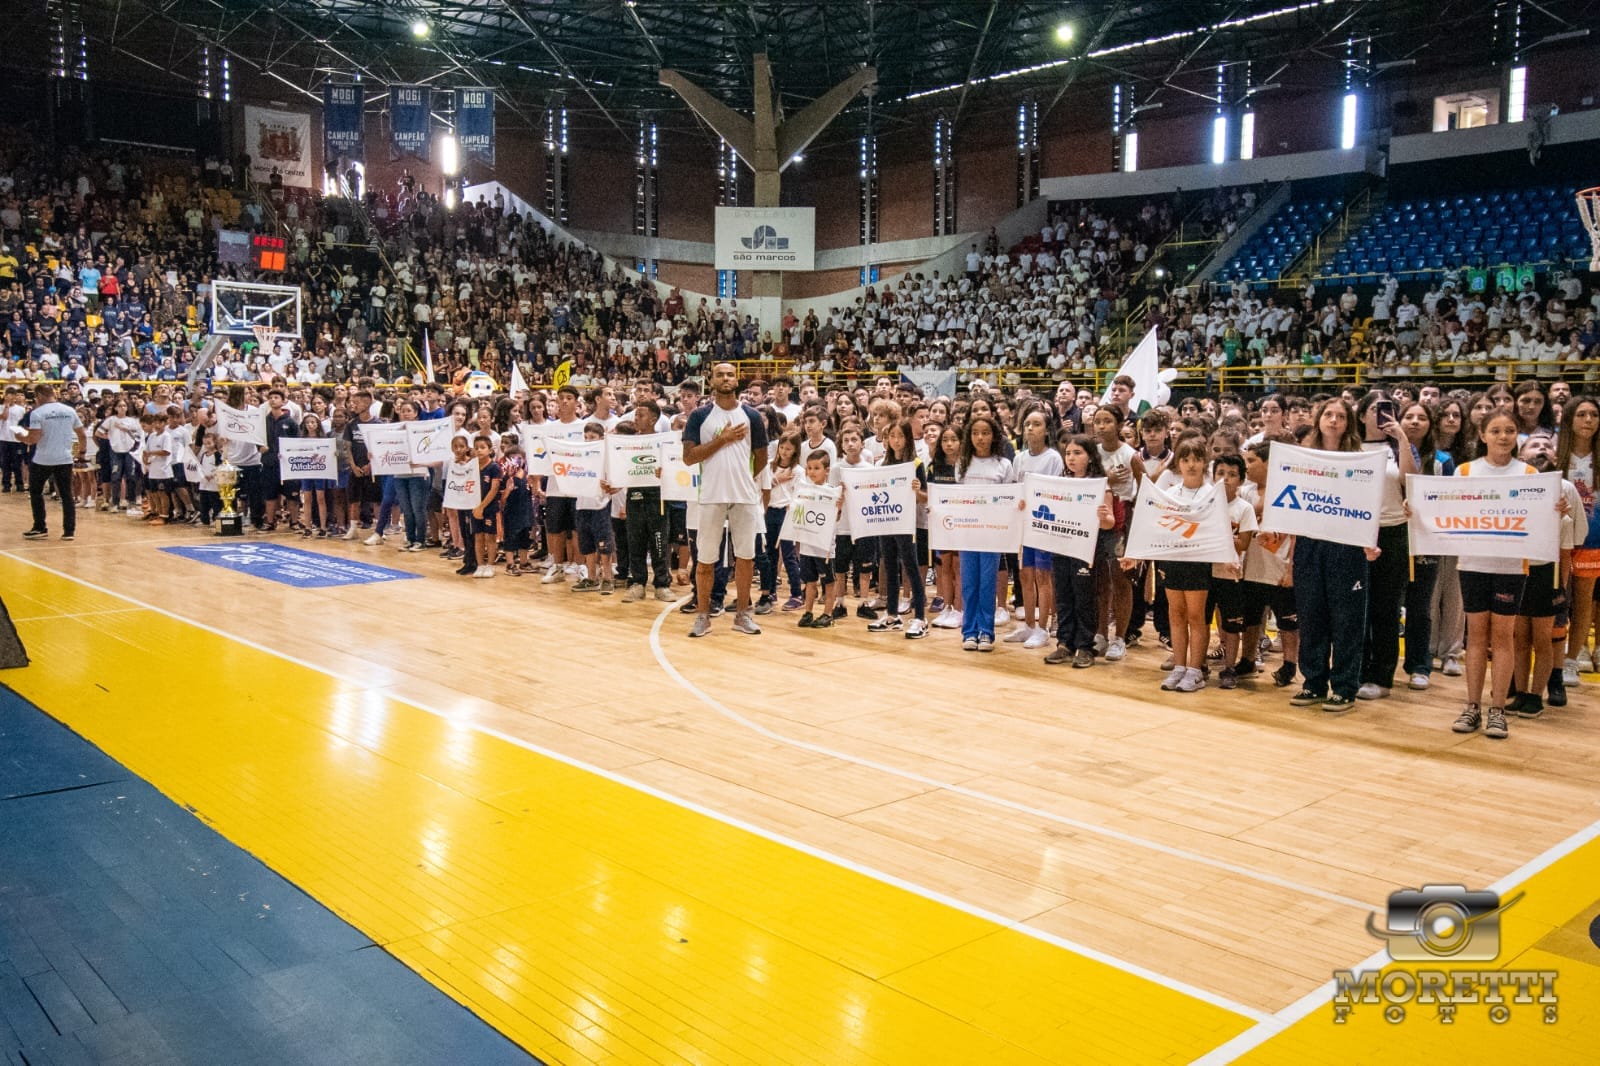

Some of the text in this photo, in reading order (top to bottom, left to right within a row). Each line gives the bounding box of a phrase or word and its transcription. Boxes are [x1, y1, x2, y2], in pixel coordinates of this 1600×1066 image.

[332, 88, 355, 100] MOGI
[398, 90, 421, 101] MOGI
[463, 92, 485, 104] MOGI
[327, 130, 359, 140] CAMPEÃO
[394, 131, 425, 141] CAMPEÃO
[460, 135, 489, 144] CAMPEÃO
[291, 463, 326, 471] Alfabeto
[1301, 492, 1341, 505] TOMÁS
[861, 504, 903, 516] OBJETIVO
[1306, 504, 1372, 520] AGOSTINHO
[1480, 507, 1528, 515] COLÉGIO
[1435, 516, 1527, 530] UNISUZ
[1032, 521, 1049, 530] são
[1051, 525, 1090, 538] marcos
